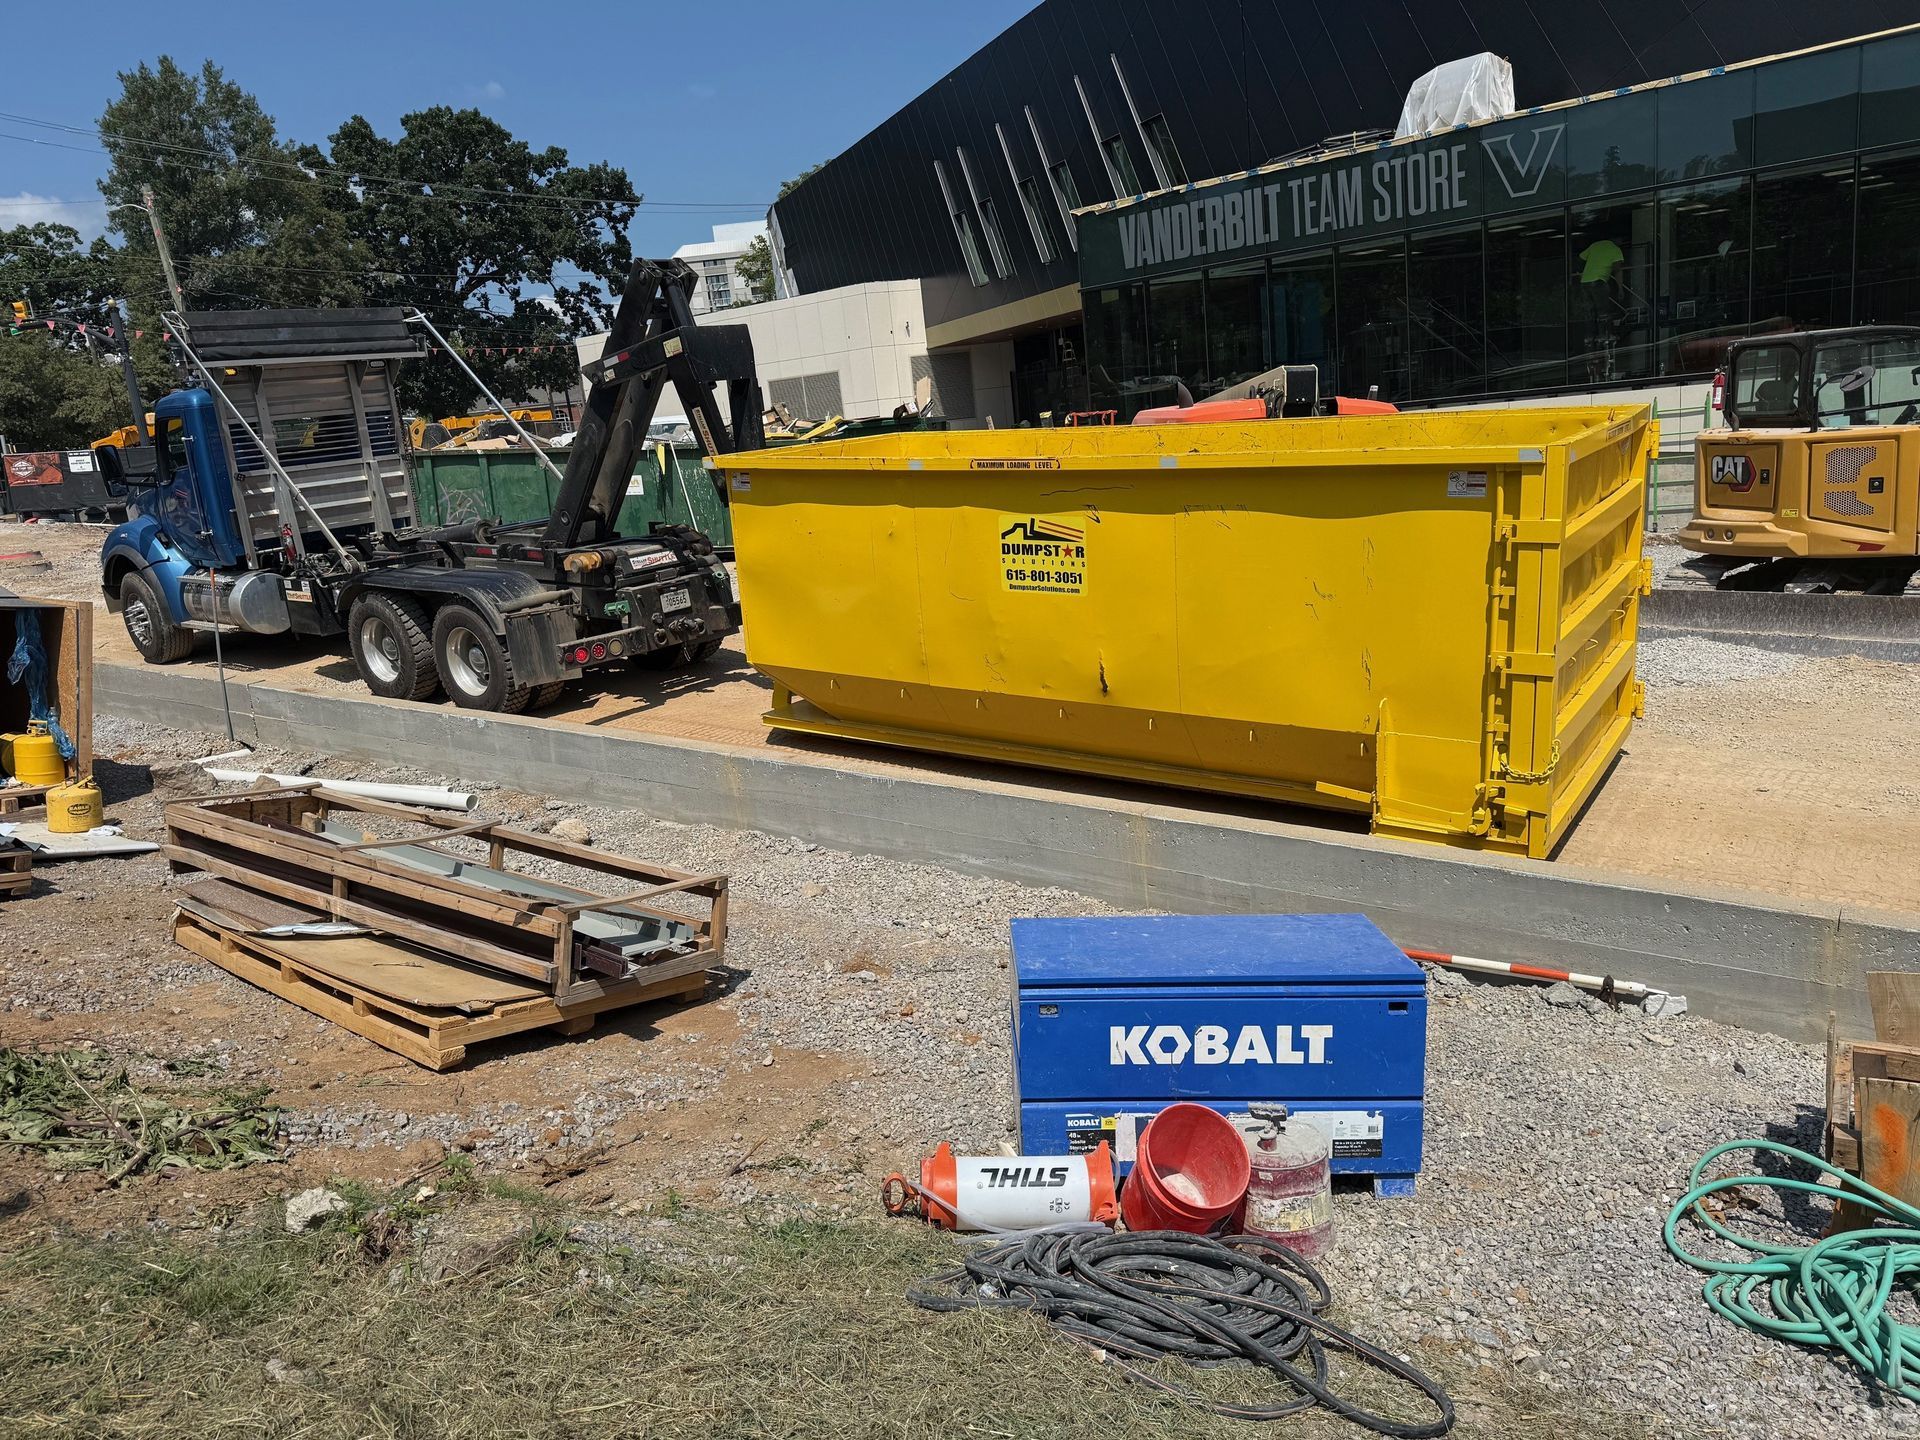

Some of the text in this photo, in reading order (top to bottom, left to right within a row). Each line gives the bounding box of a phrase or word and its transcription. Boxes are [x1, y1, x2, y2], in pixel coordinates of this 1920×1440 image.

[1118, 183, 1280, 270] VANDERBILT
[1288, 166, 1363, 237] TEAM
[1372, 143, 1468, 223] STORE
[976, 461, 1054, 469] MAXIMUM LOADING LEVEL
[1712, 456, 1746, 484] CAT
[1001, 558, 1086, 567] SOLUTIONS
[1006, 569, 1083, 584] 615-801-3051
[1009, 584, 1080, 594] DumpstarSolutions.com
[1110, 1024, 1333, 1065] KOBALT
[1067, 1119, 1100, 1127] KOBALT
[980, 1167, 1069, 1188] STIHL
